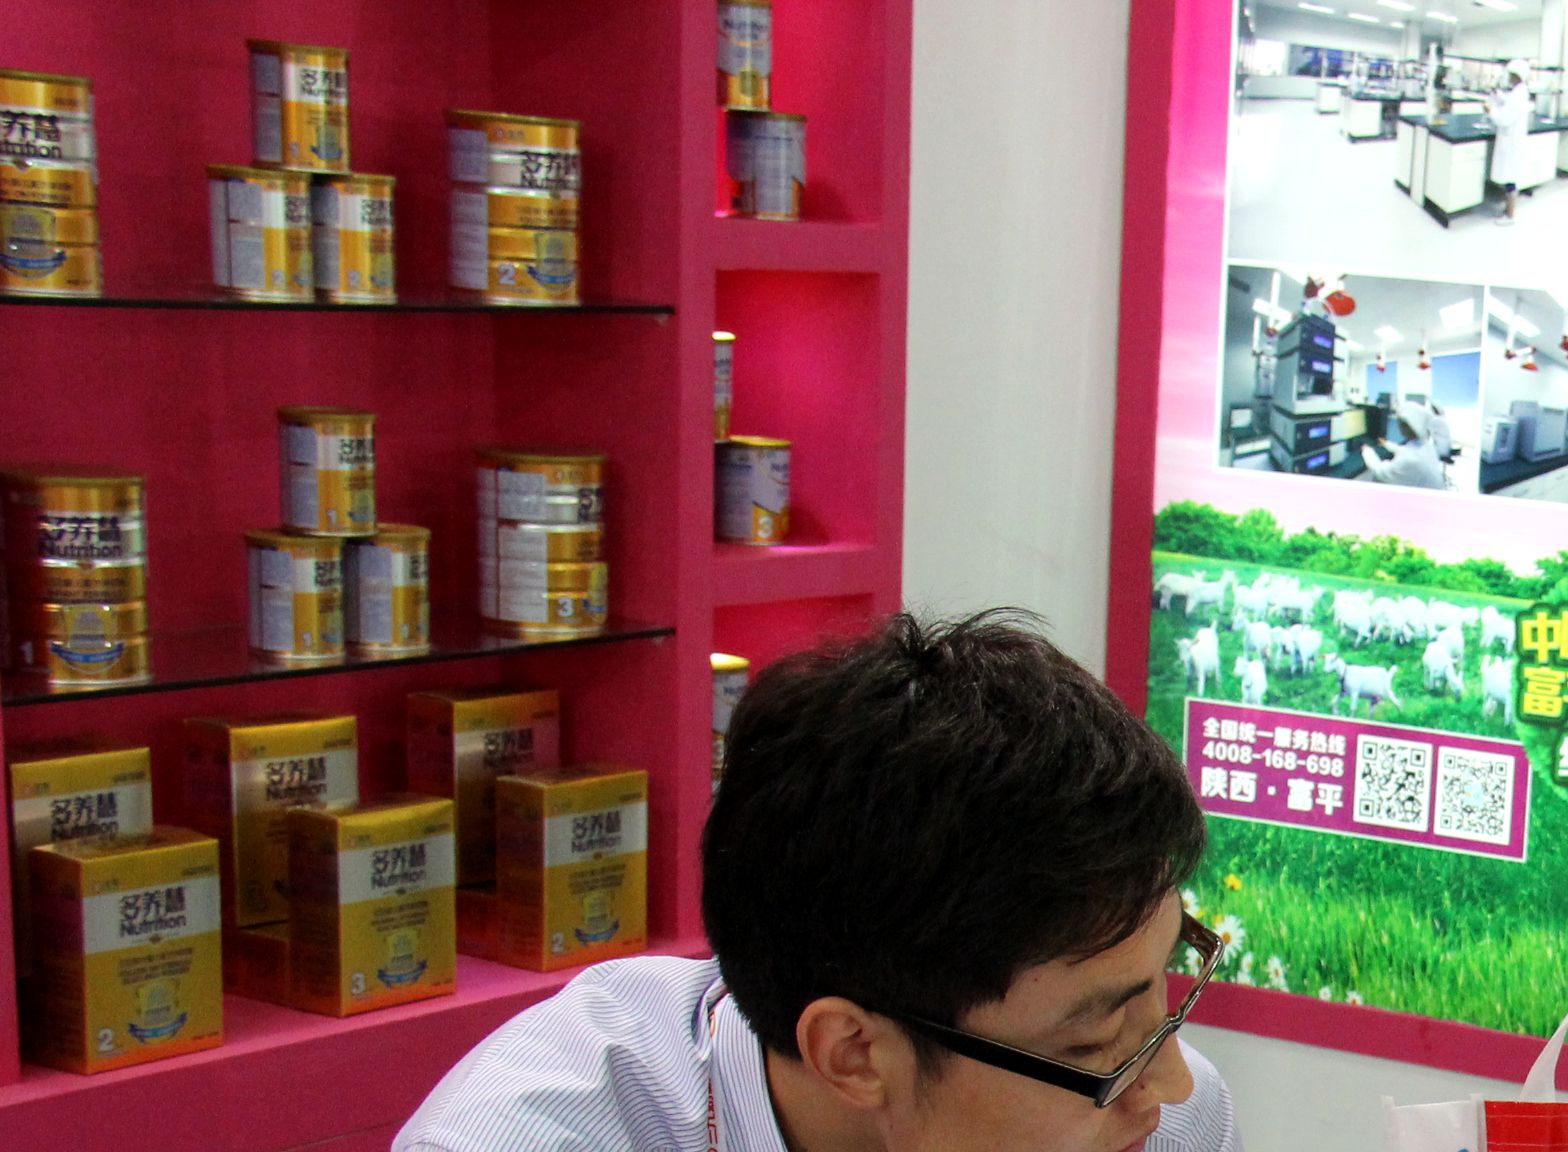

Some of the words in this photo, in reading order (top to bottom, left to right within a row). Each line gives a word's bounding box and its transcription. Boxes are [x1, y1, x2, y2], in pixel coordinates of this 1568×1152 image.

[498, 263, 517, 285] 2
[558, 596, 575, 618] 3
[1202, 716, 1347, 756] 全国统一服务热线
[1201, 741, 1345, 777] 4008-168-698
[119, 914, 188, 938] Nutrition
[352, 972, 366, 995] 3
[98, 1028, 113, 1051] 2
